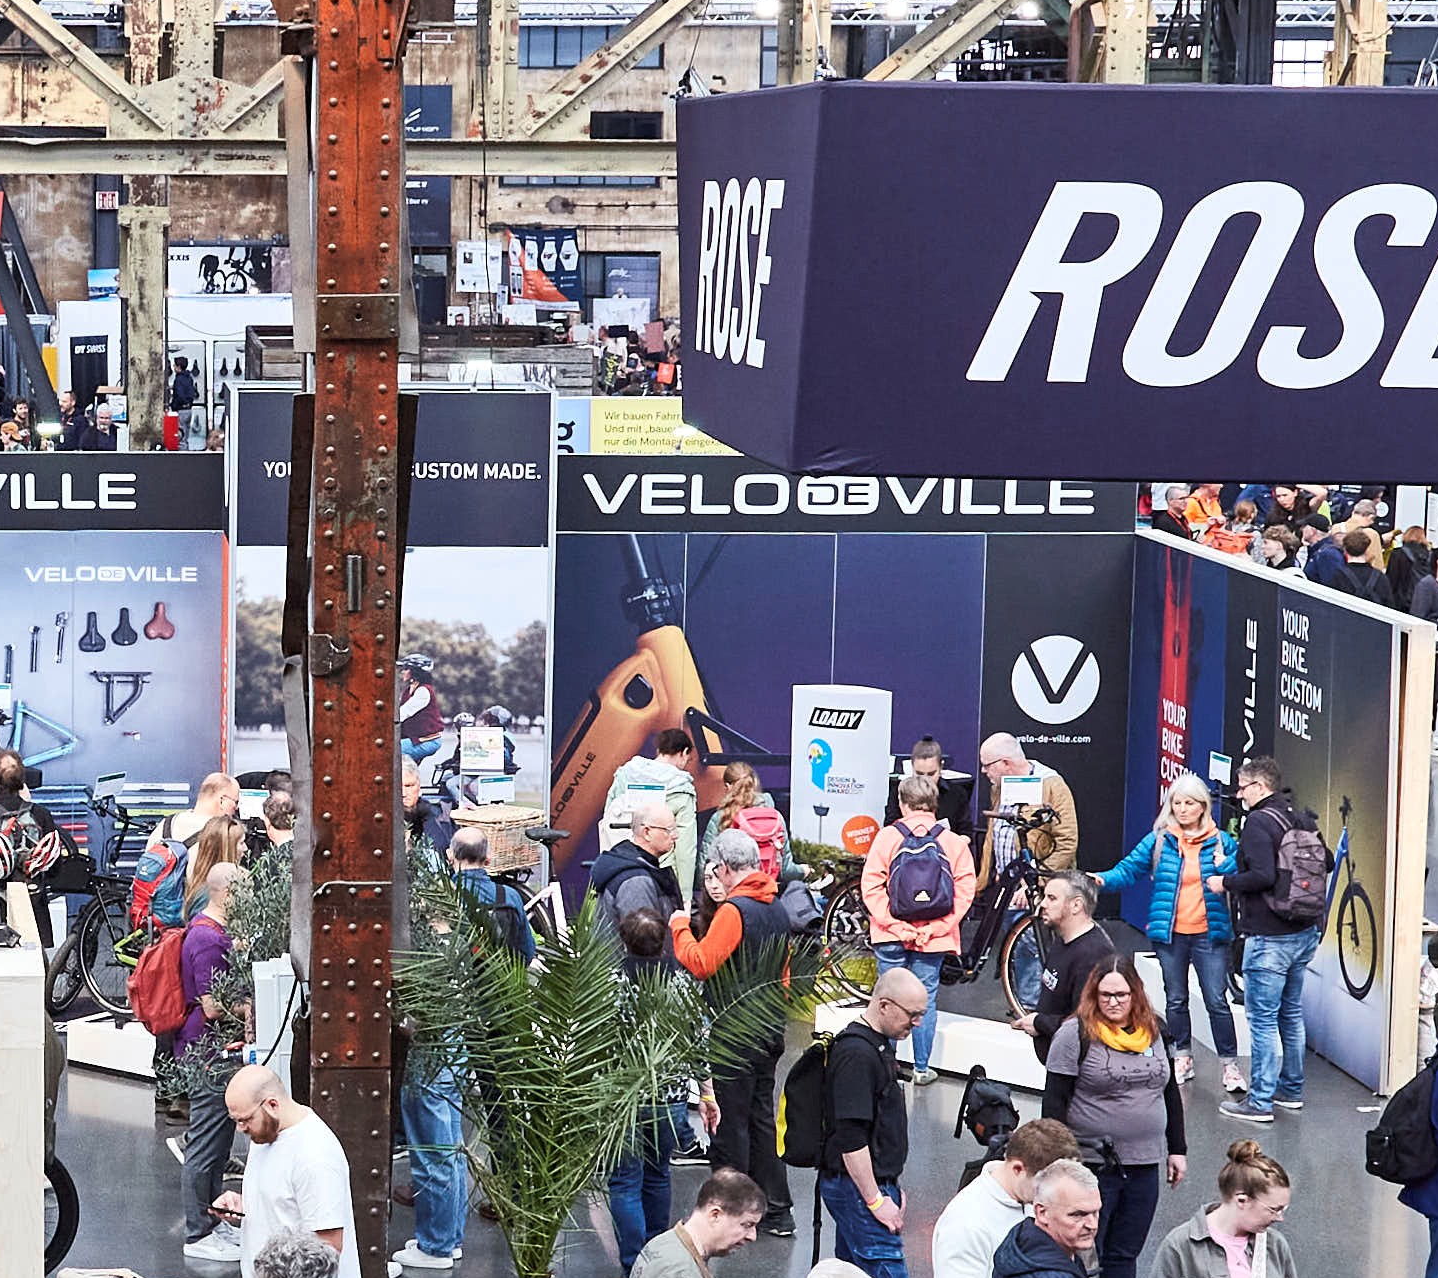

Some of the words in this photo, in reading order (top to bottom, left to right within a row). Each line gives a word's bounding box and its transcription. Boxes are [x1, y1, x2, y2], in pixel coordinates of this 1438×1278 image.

[695, 177, 786, 370] ROSE
[604, 411, 619, 420] Wir
[411, 462, 478, 479] USTOM
[483, 463, 542, 480] MADE.
[1282, 608, 1310, 642] YOUR
[1281, 640, 1309, 674] BIKE.
[1242, 618, 1258, 753] VILLE
[1280, 672, 1323, 713] CUSTOM
[1162, 698, 1187, 730] YOUR
[1279, 704, 1312, 741] MADE.
[1161, 730, 1185, 759] BIKE.
